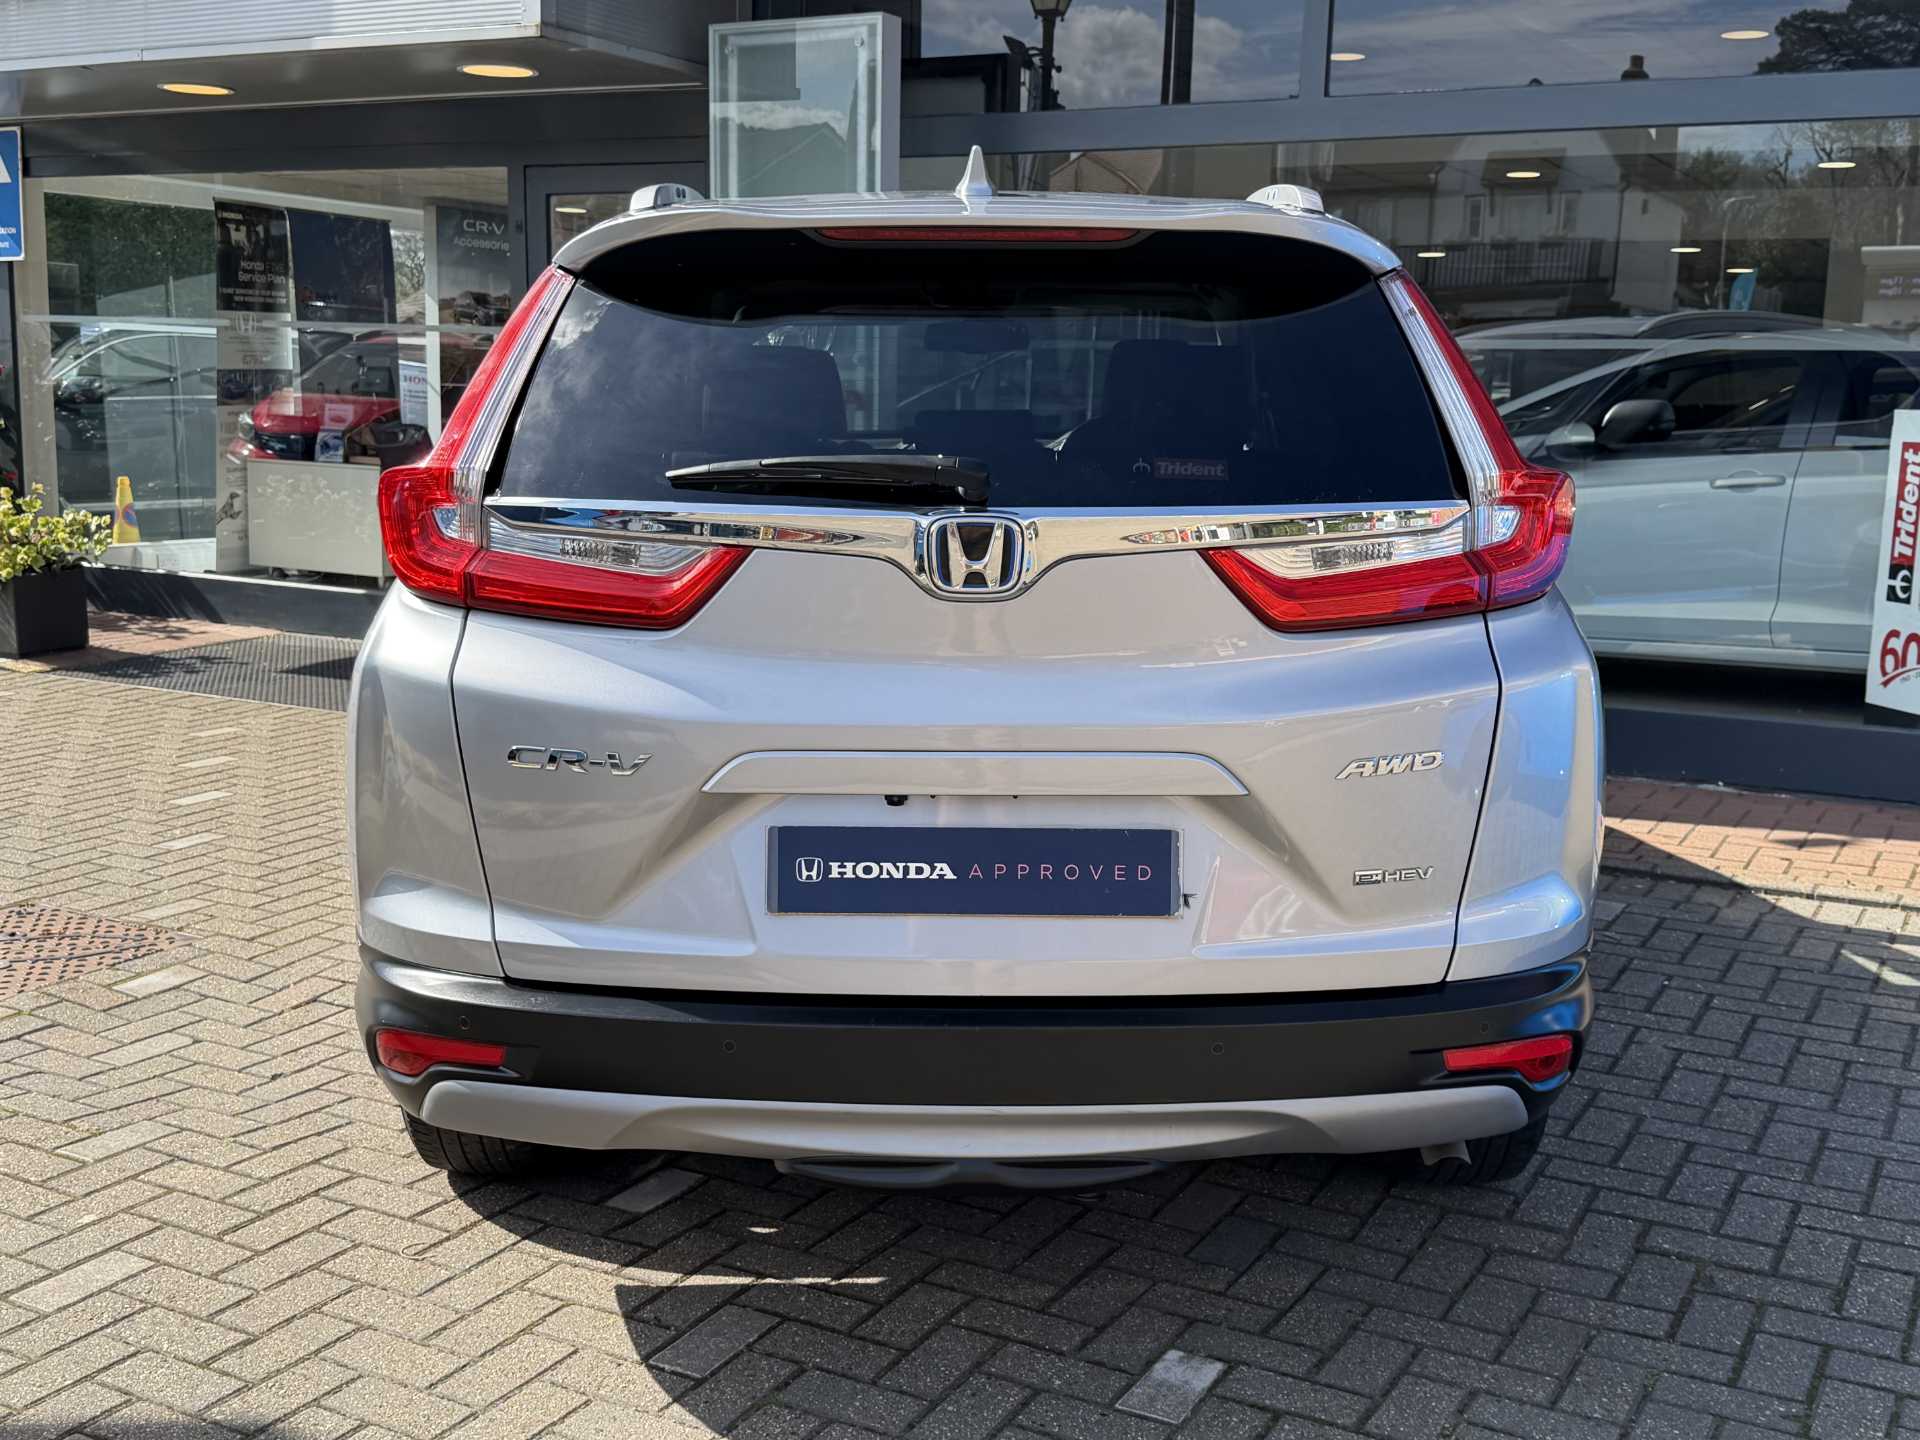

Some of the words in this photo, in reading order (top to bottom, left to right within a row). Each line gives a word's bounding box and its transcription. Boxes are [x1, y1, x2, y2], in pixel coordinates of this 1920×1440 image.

[1157, 462, 1225, 476] Trident
[1894, 448, 1920, 558] Trident
[507, 745, 652, 776] CR-V
[1335, 750, 1445, 780] AWD
[828, 862, 957, 880] HONDA
[968, 863, 1153, 881] APPROVED
